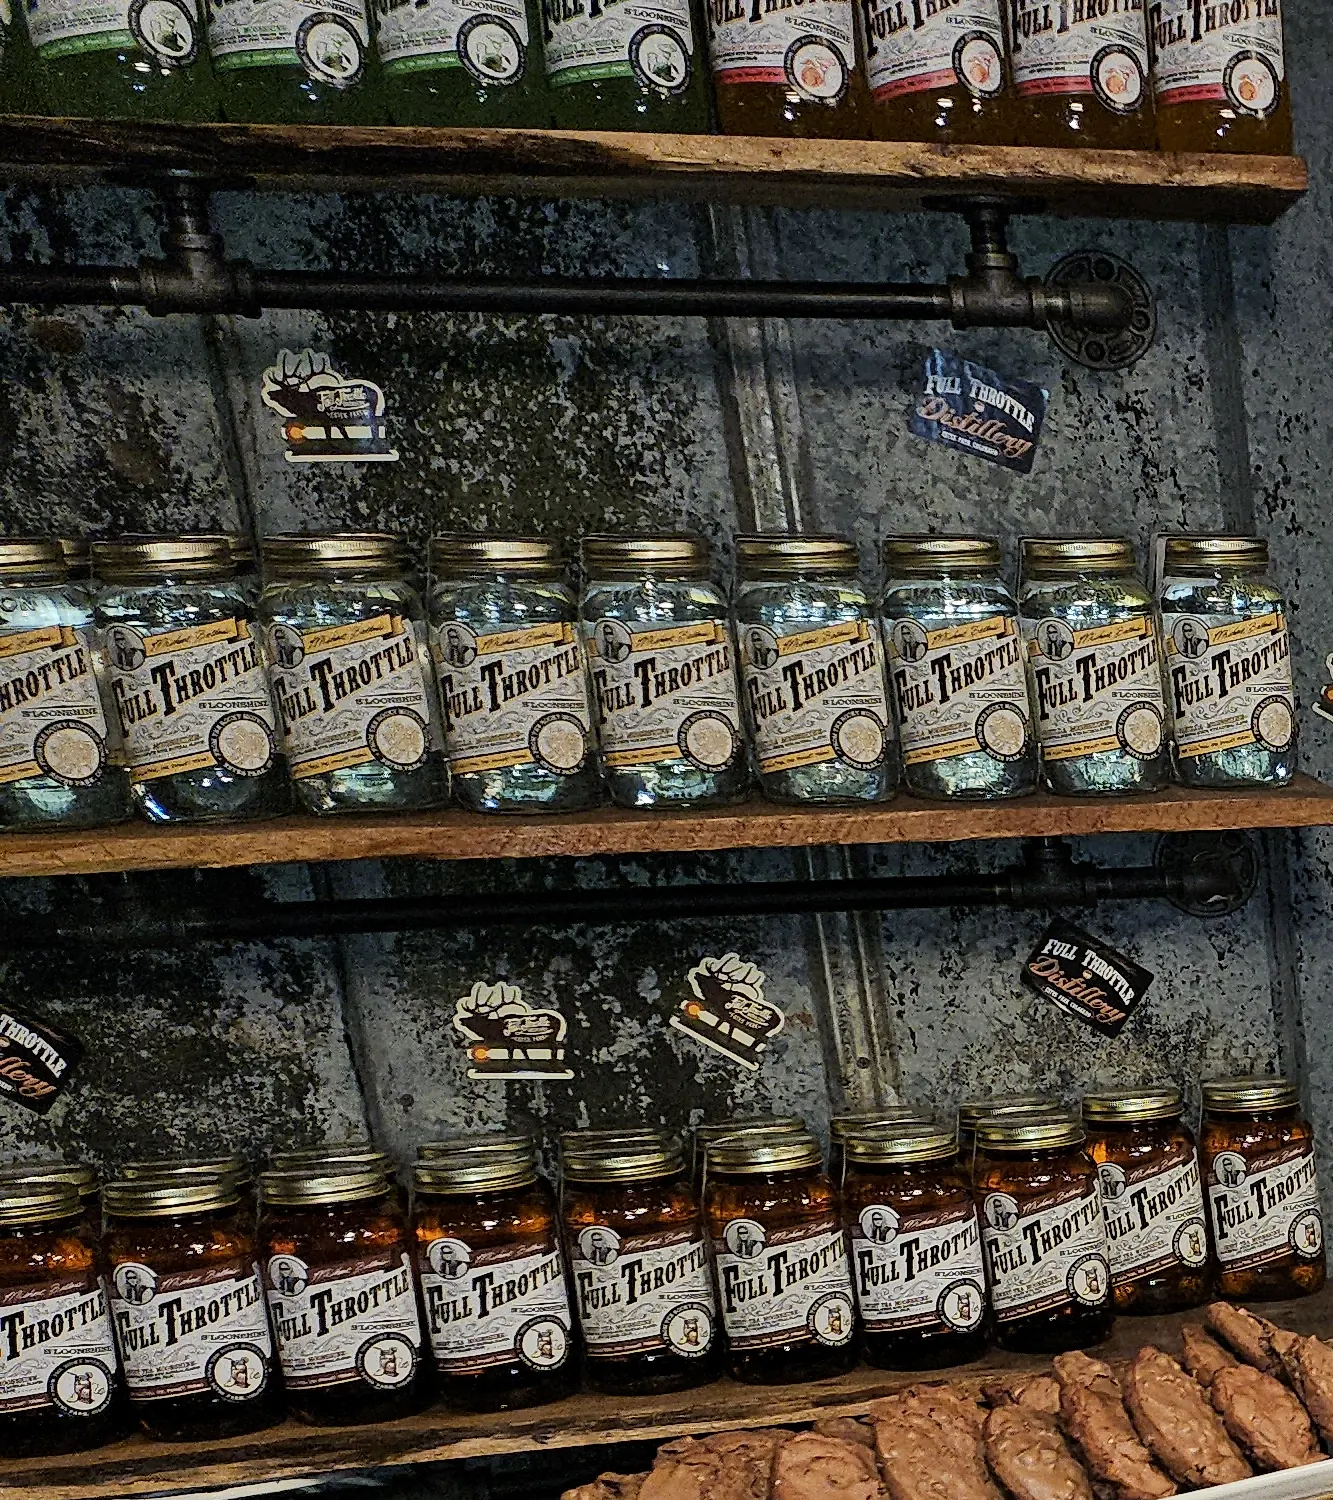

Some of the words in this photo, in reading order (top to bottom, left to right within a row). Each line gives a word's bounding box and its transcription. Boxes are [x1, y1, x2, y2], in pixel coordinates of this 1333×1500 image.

[624, 8, 688, 27] S'LOONSHINE
[1151, 4, 1188, 65] FULL
[916, 396, 1034, 458] Distillery
[924, 375, 961, 394] FULL
[968, 379, 1036, 434] THROTTLE
[0, 647, 88, 712] HROTTLE
[112, 677, 158, 738] FULL
[151, 641, 261, 717] THROTTLE
[199, 700, 269, 710] S'LOONSHINE
[274, 675, 316, 736] FULL
[309, 636, 413, 713] THROTTLE
[440, 674, 483, 731] FULL
[480, 646, 581, 713] THROTTLE
[594, 669, 636, 724] FULL
[634, 645, 730, 708] THROTTLE
[747, 675, 787, 732] FULL
[782, 641, 876, 712] THROTTLE
[895, 669, 933, 724] FULL
[930, 638, 1020, 704] THROTTLE
[1035, 667, 1078, 720] FULL
[1076, 638, 1157, 703] THROTTLE
[1171, 665, 1214, 719] FULL
[1211, 633, 1289, 698] THROTTLE
[22, 706, 98, 719] S'LOONSHINE
[1028, 956, 1126, 1024] Distillery
[1041, 938, 1078, 960] FULL
[1081, 949, 1125, 1006] THROTTLE
[1213, 1194, 1253, 1240] FULL
[1250, 1155, 1316, 1220] THROTTL
[577, 1271, 620, 1319] FULL
[621, 1240, 705, 1305] THROTTL
[722, 1265, 768, 1313] FULL
[768, 1237, 844, 1297] THROTTL
[858, 1250, 900, 1296] FULL
[900, 1220, 979, 1282] THROTTL
[986, 1238, 1028, 1287] FULL
[116, 1310, 160, 1361] FULL
[202, 1331, 267, 1341] S'LOONSHINE
[270, 1302, 311, 1342] FULL
[426, 1286, 472, 1334] FULL
[44, 1346, 112, 1356] S'LOONSHINE
